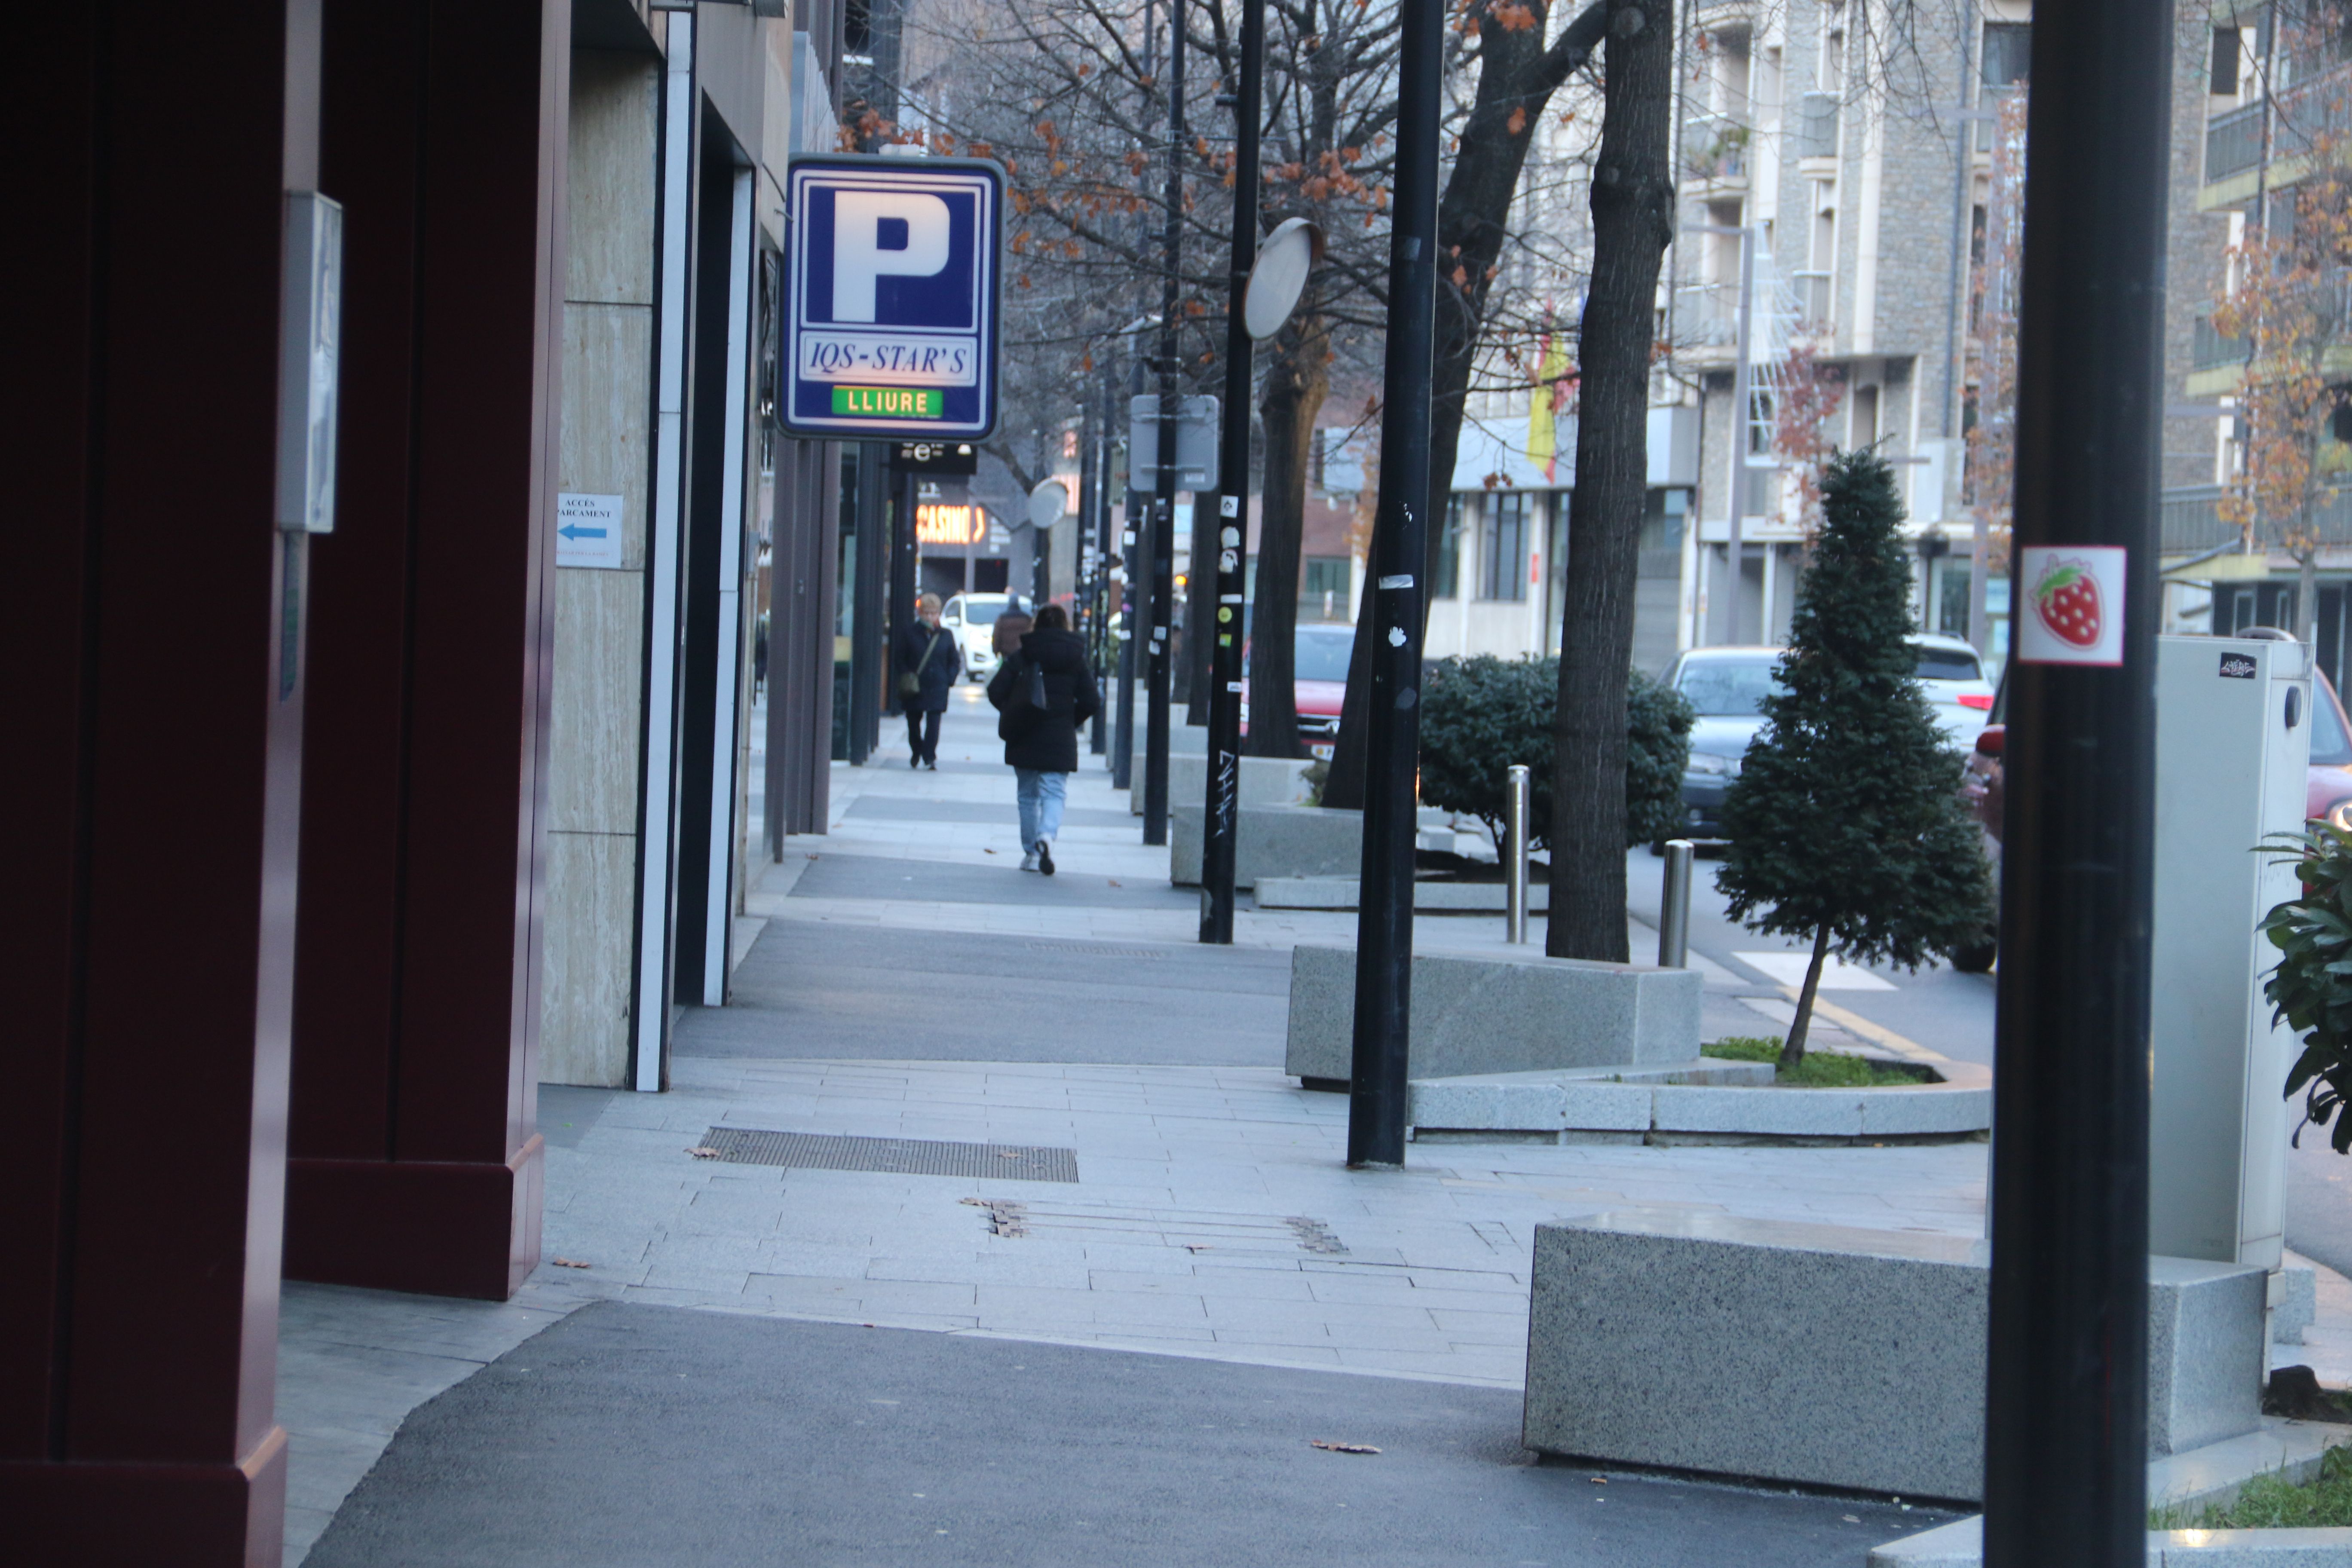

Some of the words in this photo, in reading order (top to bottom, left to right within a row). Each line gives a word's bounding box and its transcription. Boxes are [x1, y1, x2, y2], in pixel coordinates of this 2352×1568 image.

[833, 190, 950, 322] P
[848, 390, 927, 413] LLIURE
[557, 509, 610, 518] ARCAMENT
[566, 498, 594, 507] ACCÉS
[916, 504, 970, 544] CASINO
